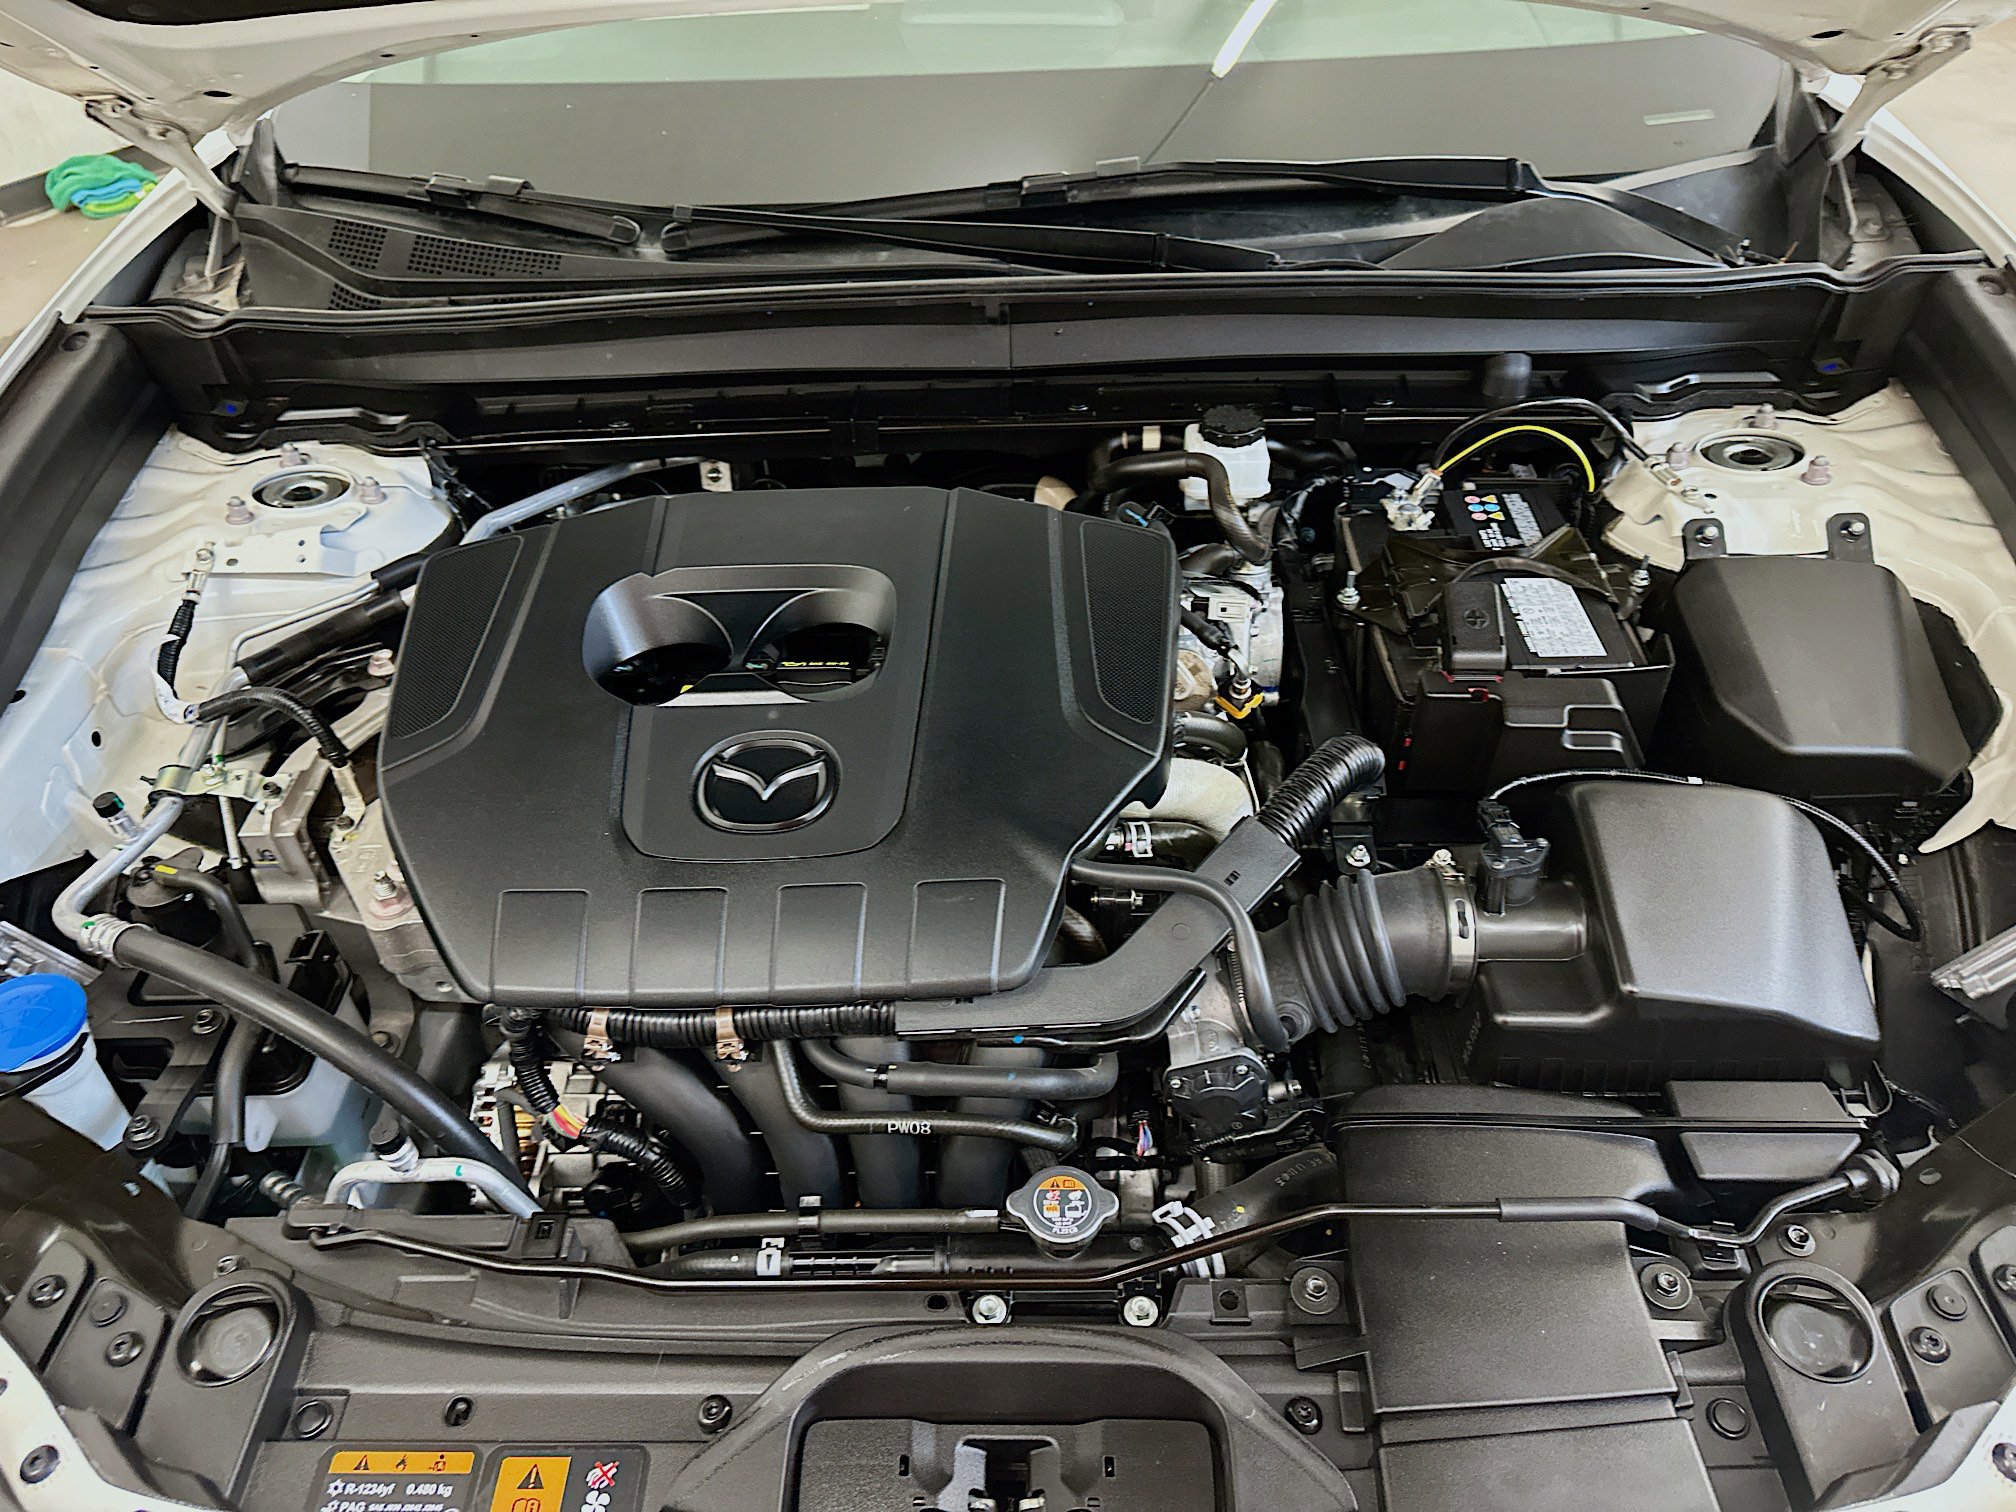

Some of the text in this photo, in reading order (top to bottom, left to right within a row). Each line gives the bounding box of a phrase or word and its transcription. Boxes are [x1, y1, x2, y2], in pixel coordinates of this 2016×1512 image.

[887, 1120, 931, 1135] PW08
[437, 1483, 453, 1498] kg
[340, 1501, 366, 1512] PAG
